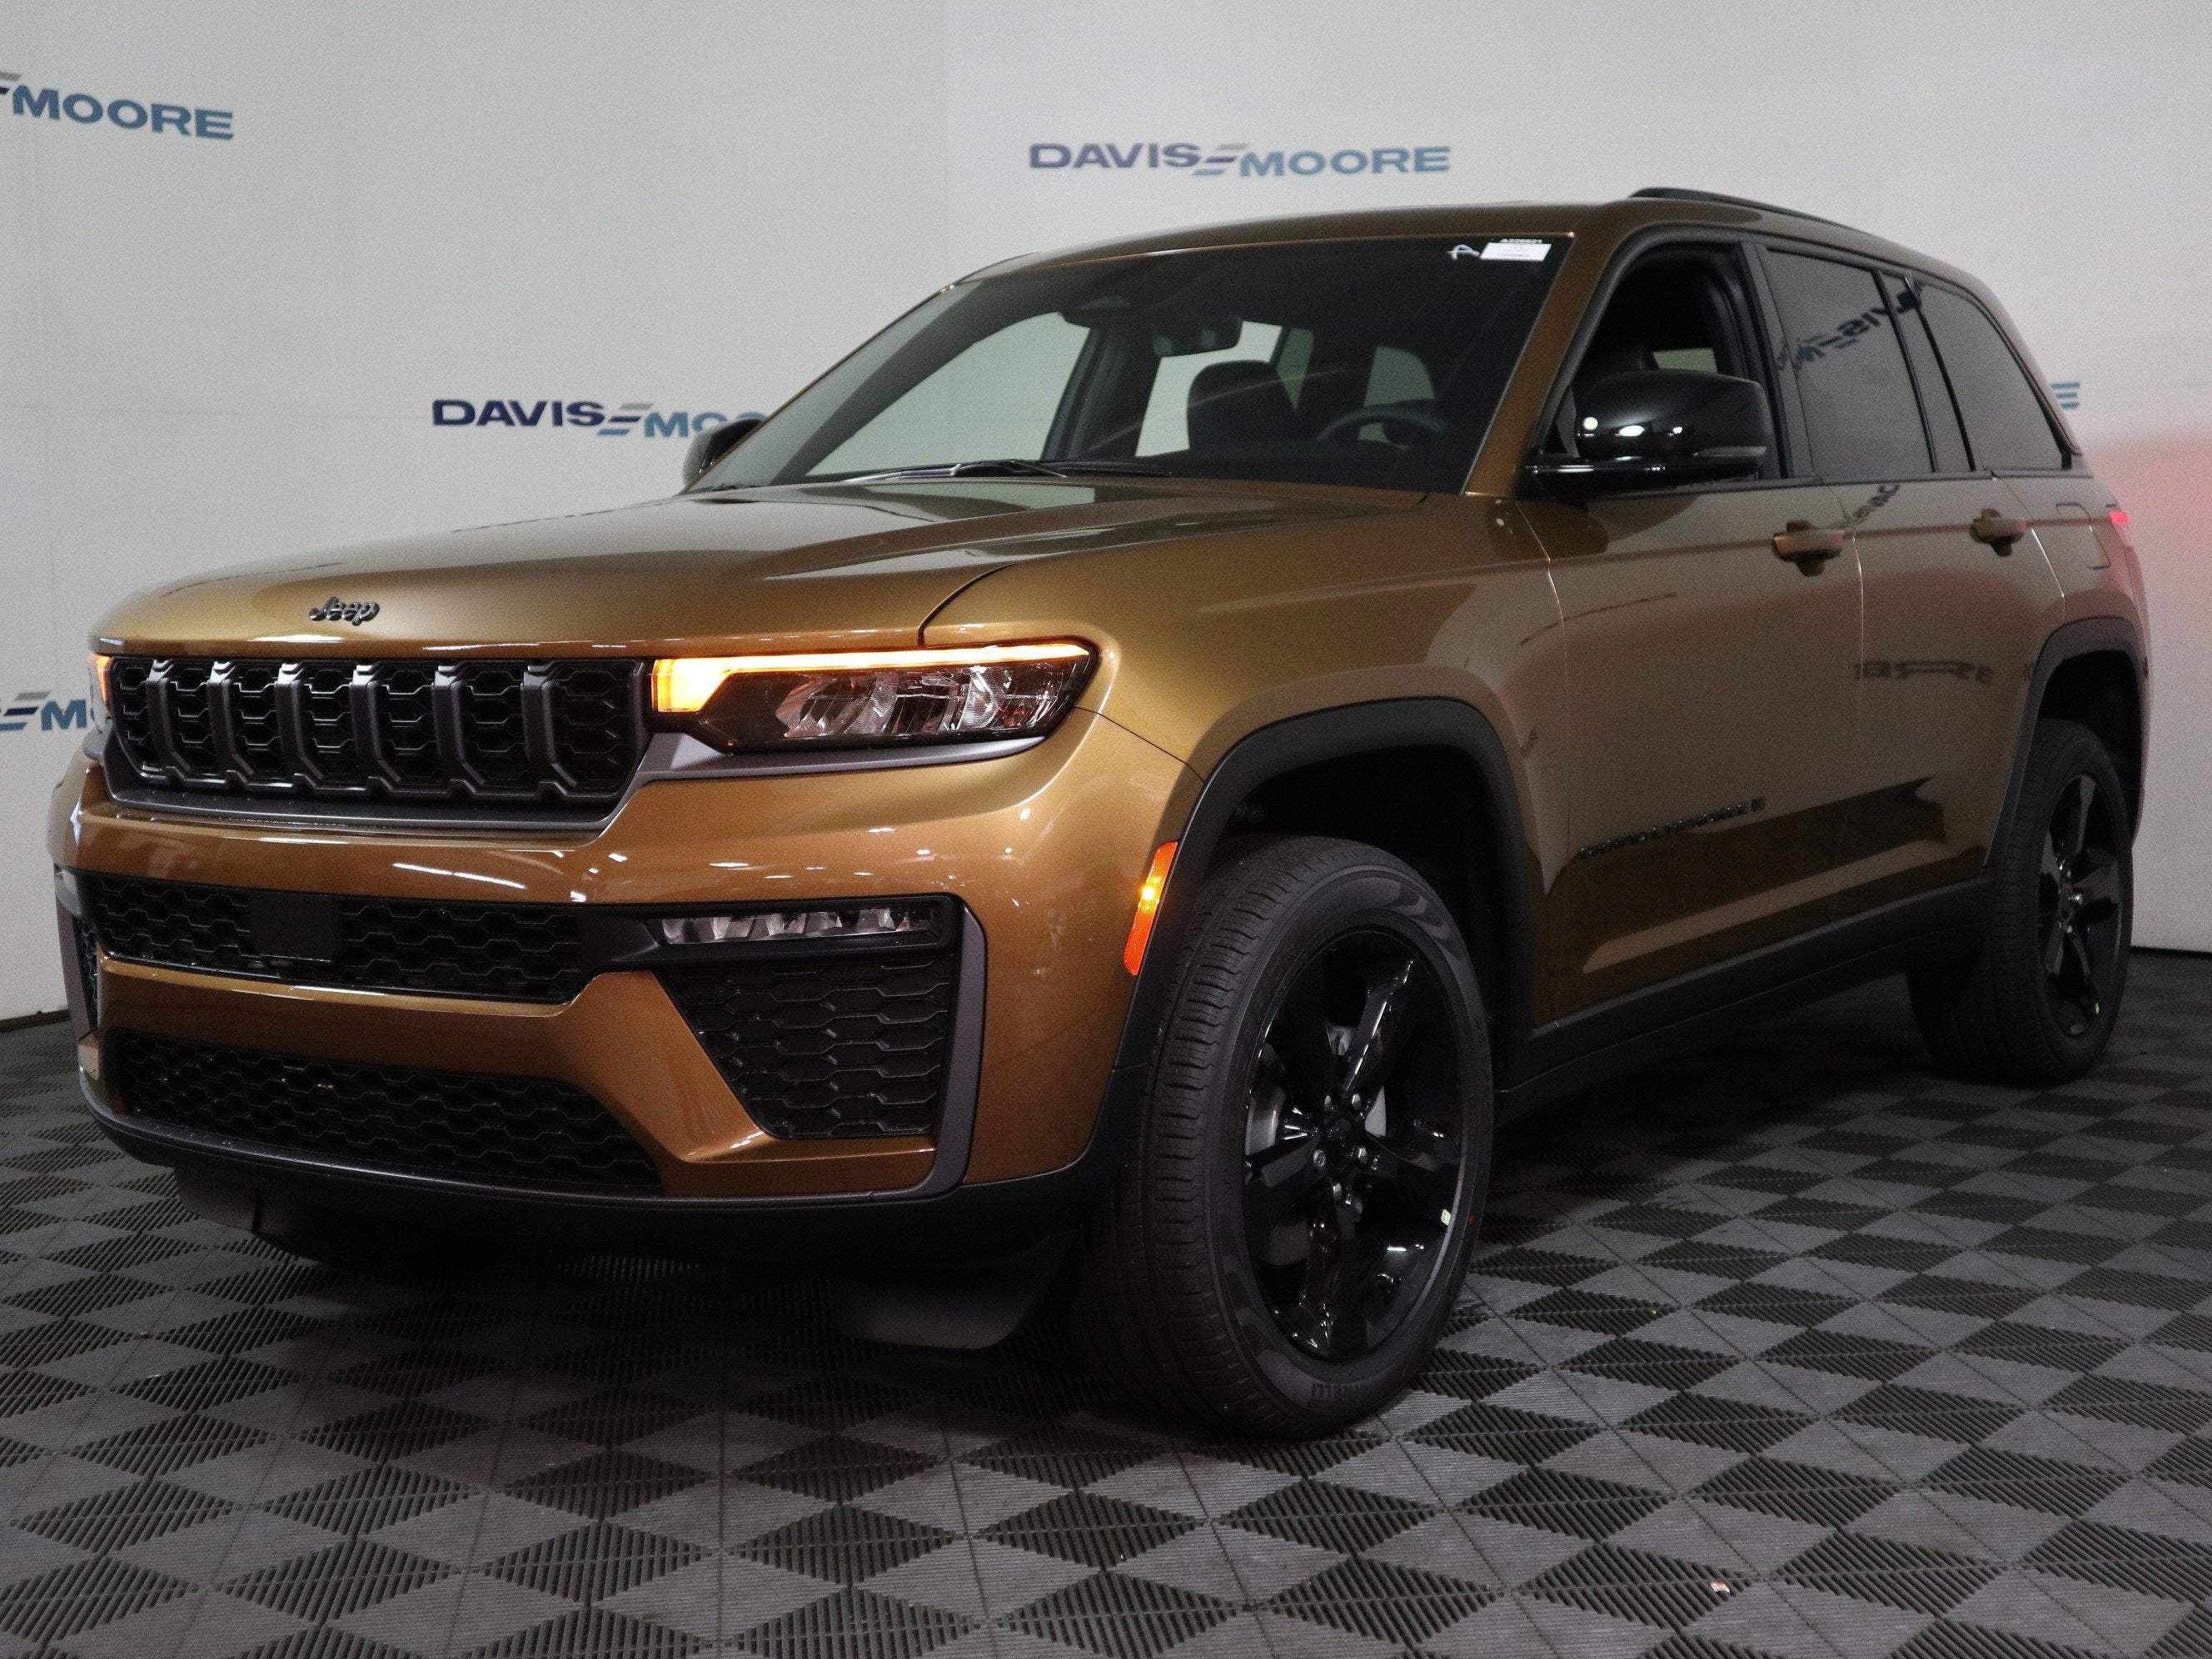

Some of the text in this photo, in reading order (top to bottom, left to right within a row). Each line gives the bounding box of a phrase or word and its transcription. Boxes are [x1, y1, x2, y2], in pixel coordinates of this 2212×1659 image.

[12, 84, 234, 140] MOORE
[1029, 142, 1451, 177] DAVIS MOORE
[431, 399, 606, 427] DAVIS
[308, 596, 380, 626] Jeep
